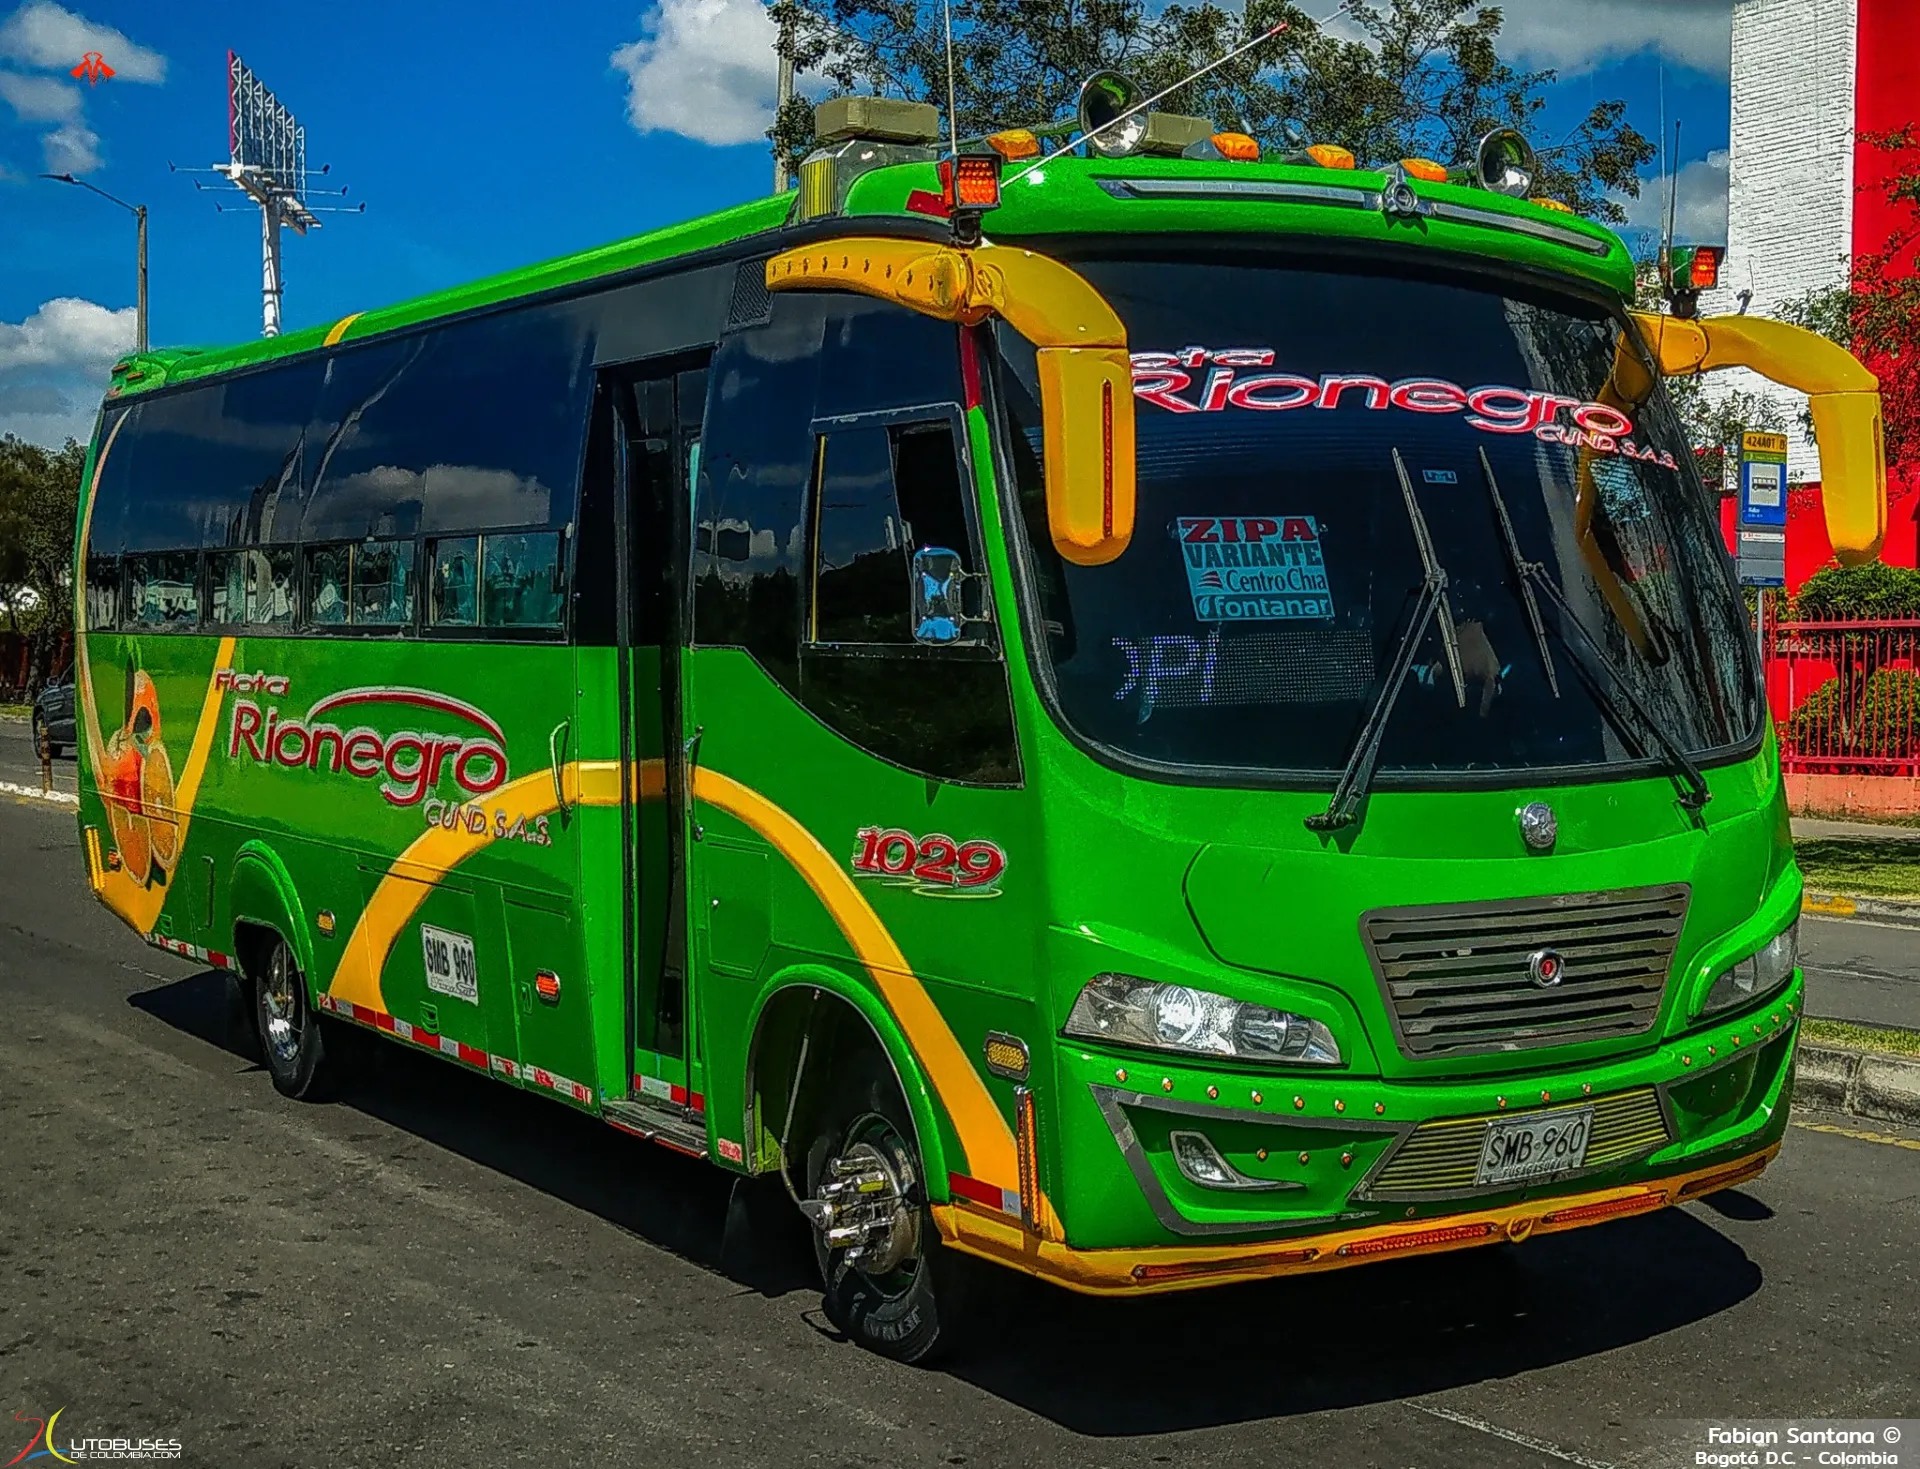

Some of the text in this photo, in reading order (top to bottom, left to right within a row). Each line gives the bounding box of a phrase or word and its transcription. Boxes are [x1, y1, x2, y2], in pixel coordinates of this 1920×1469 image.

[1130, 346, 1275, 368] ota
[1132, 367, 1633, 437] Rionegro
[1183, 518, 1318, 543] ZIPA
[1184, 542, 1323, 568] VARIANTE
[1226, 569, 1286, 592] Centro
[215, 668, 290, 696] Flota
[230, 699, 509, 808] Rionegro
[851, 826, 1007, 887] 1029
[426, 936, 475, 986] SMB 960
